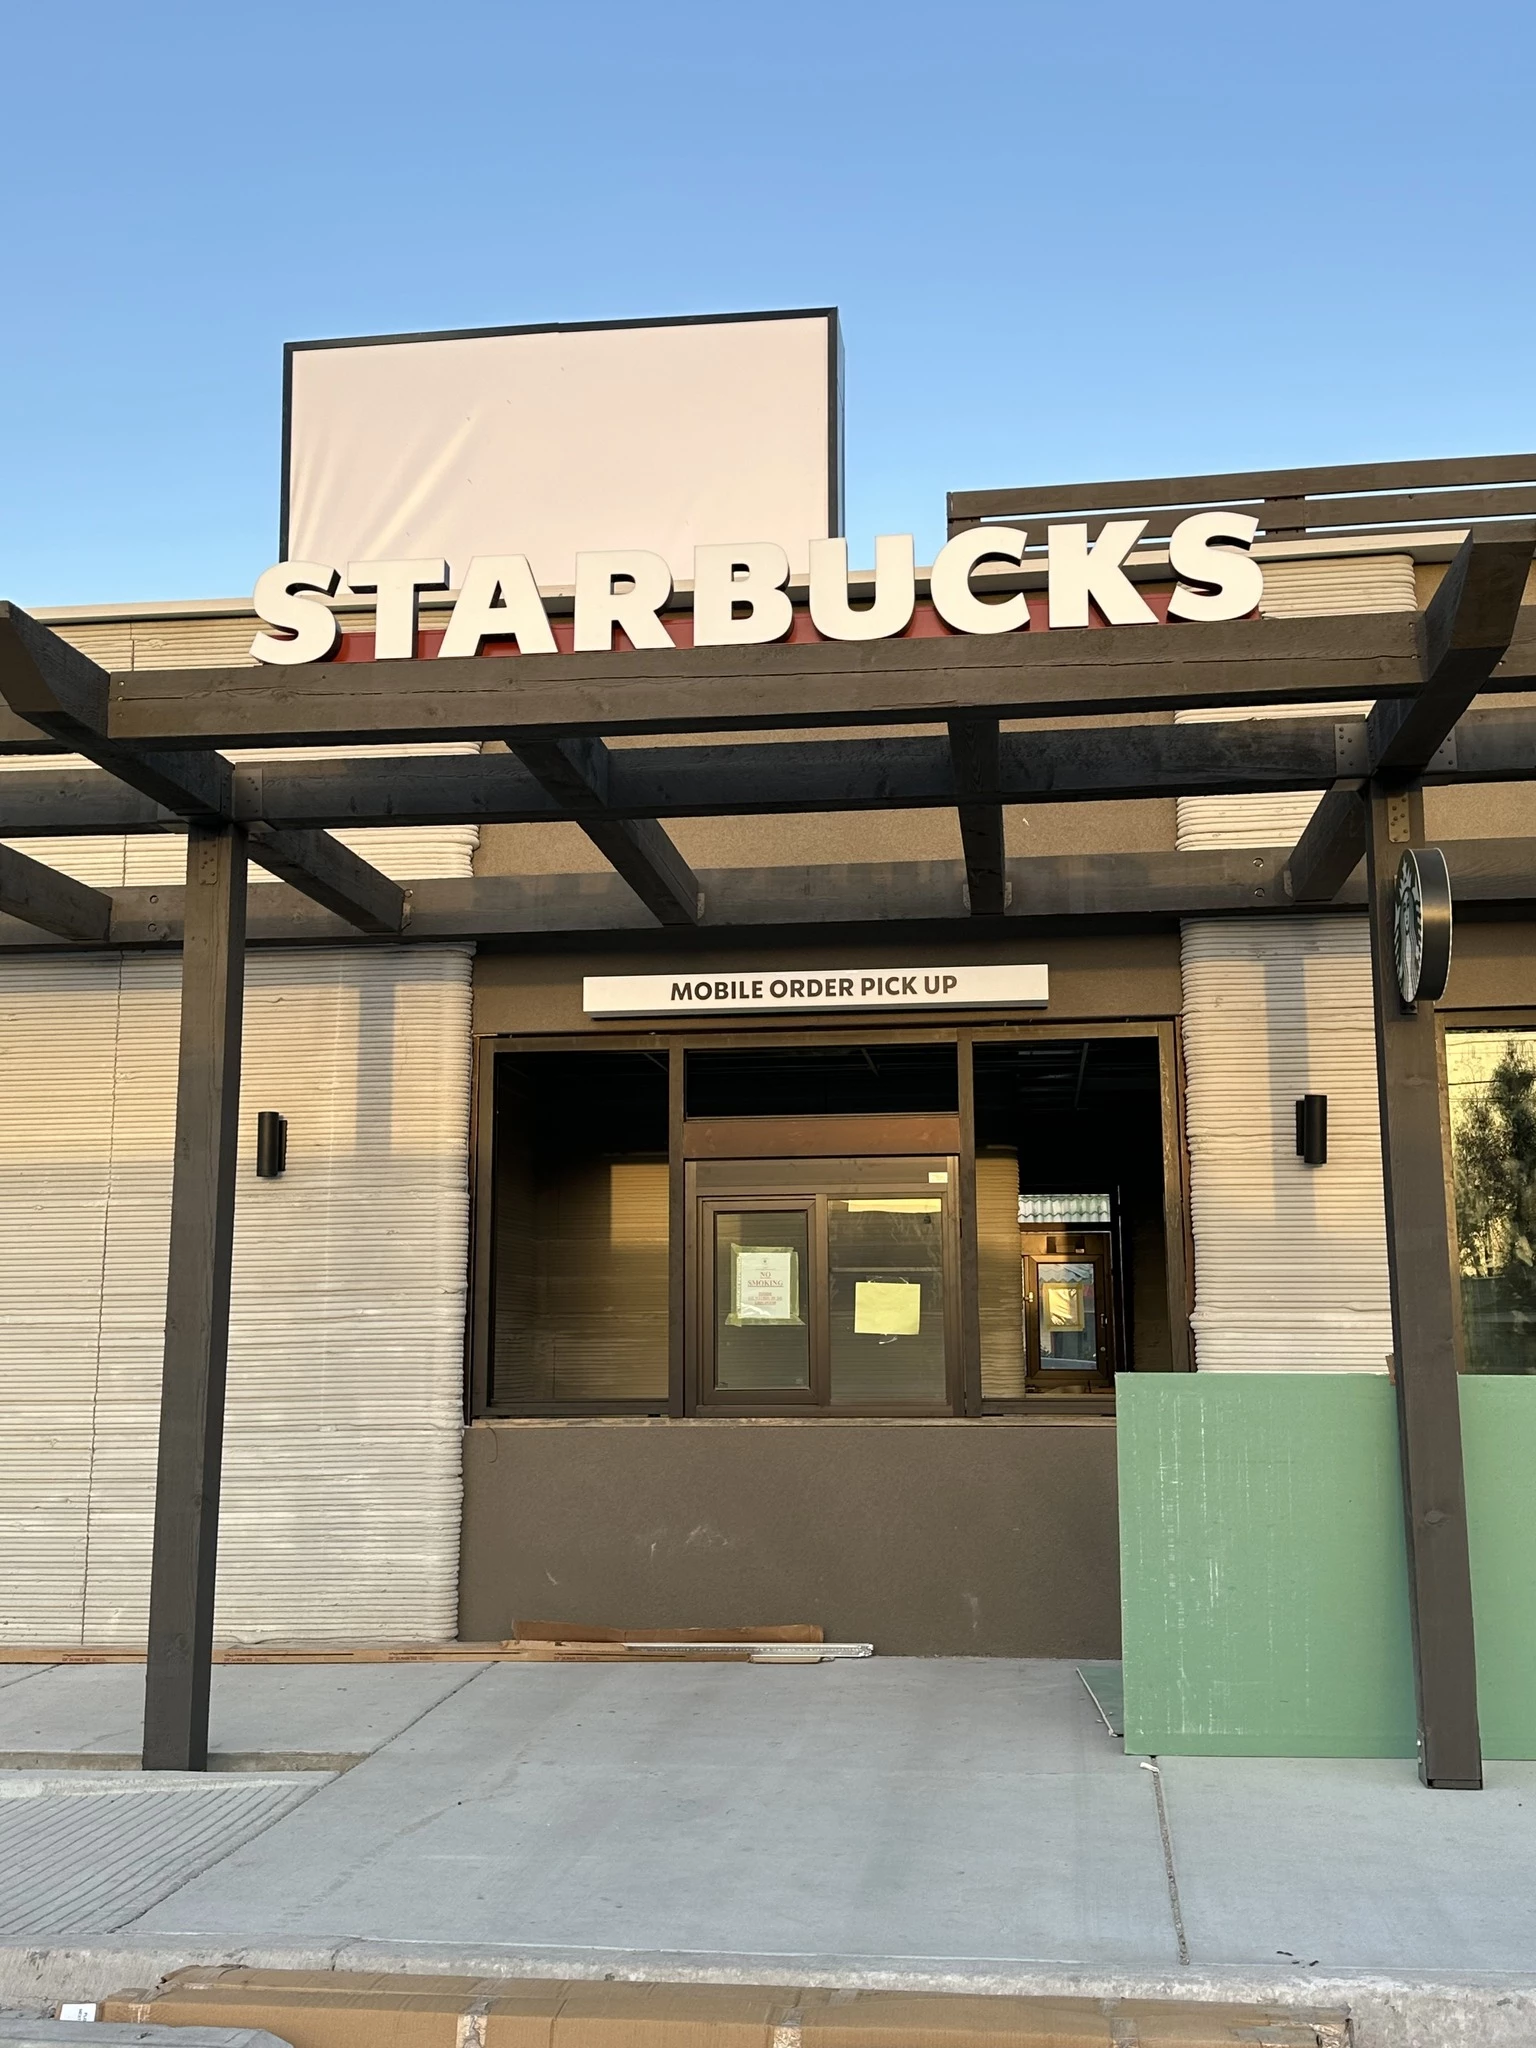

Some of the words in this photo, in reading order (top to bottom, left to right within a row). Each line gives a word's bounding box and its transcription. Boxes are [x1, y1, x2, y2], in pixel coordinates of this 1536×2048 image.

[250, 510, 1265, 666] STARBUCKS
[671, 981, 763, 1001] MOBILE
[770, 978, 854, 999] ORDER
[862, 976, 918, 997] PICK
[925, 975, 958, 996] UP
[760, 1271, 771, 1279] NO
[748, 1280, 784, 1288] SMOKING
